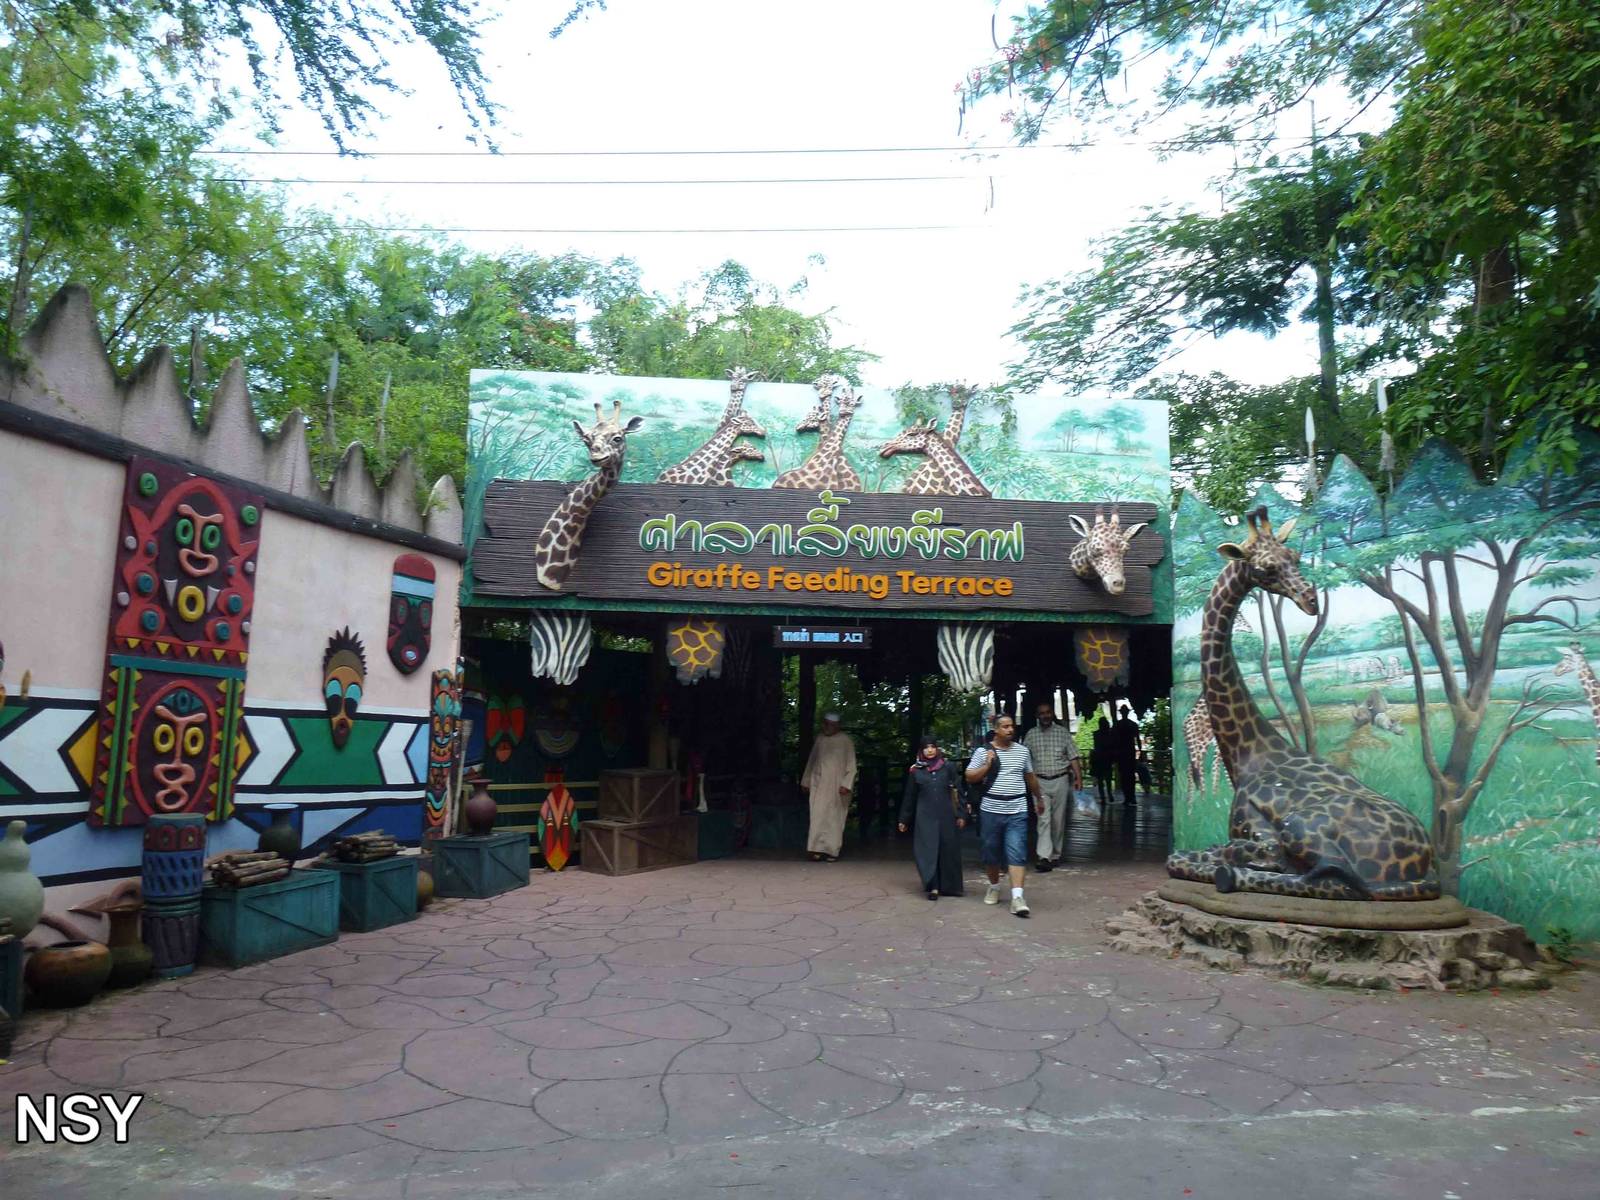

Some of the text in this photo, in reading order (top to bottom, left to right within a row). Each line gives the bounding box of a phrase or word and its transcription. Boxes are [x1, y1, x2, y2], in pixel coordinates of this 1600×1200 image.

[647, 562, 1013, 599] Giraffe Feeding Terrace
